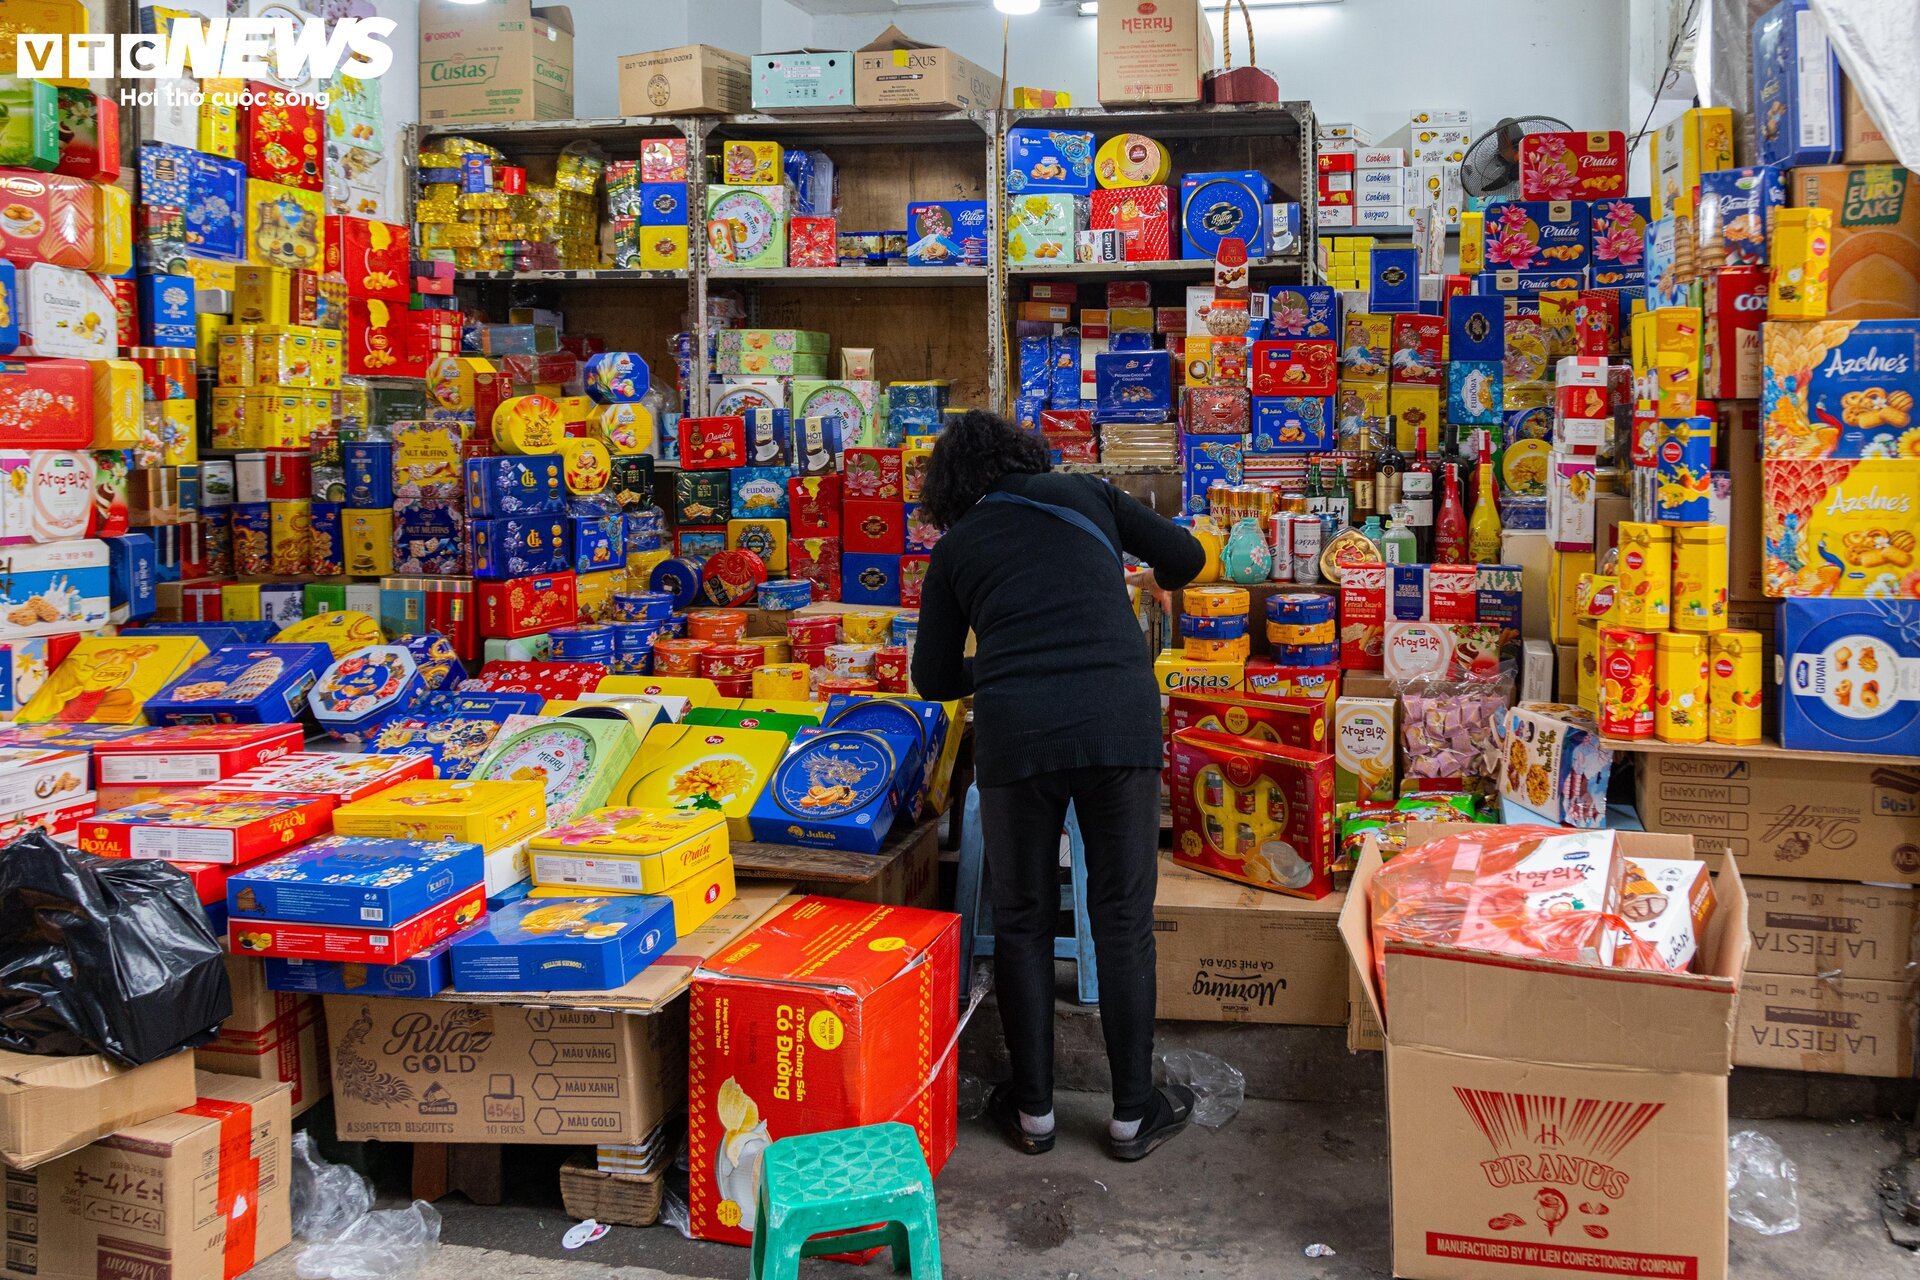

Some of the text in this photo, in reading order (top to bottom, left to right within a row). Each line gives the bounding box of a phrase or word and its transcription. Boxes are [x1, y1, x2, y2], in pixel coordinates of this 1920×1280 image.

[1121, 17, 1173, 33] MERRY
[434, 30, 461, 40] ORION
[431, 61, 487, 82] Custas
[536, 63, 564, 83] Custas
[65, 156, 91, 164] Coffee
[1365, 153, 1391, 164] Cookies
[1579, 155, 1618, 168] Praise
[1365, 172, 1391, 182] Cookies
[1365, 191, 1391, 202] Cookies
[957, 209, 985, 223] Ritaz
[1364, 209, 1389, 220] Cookies
[1845, 199, 1900, 221] CAKE
[1540, 224, 1579, 238] Praise
[1519, 279, 1549, 290] Praise
[43, 292, 81, 308] Chocolate
[1823, 347, 1910, 378] Azolne's
[704, 427, 733, 444] Daniel
[806, 432, 822, 440] HOT
[38, 470, 91, 496] 자연의맛
[1826, 486, 1911, 516] Azolne's
[1393, 636, 1441, 653] 자연의맛
[1165, 671, 1230, 689] Custas
[1250, 673, 1278, 688] Tipo
[1297, 673, 1324, 689] Tipo
[1815, 656, 1826, 694] GIOVANI
[1341, 725, 1387, 742] 자연의맛
[257, 745, 288, 764] Praise
[537, 751, 566, 771] MERRY
[1698, 762, 1726, 777] MÀU
[1663, 785, 1725, 801] MÀU XANH
[1662, 809, 1726, 827] MÀU VÀNG
[1810, 806, 1861, 815] PREMIUM
[268, 812, 306, 834] ROYAL
[1759, 804, 1861, 849] Draft
[806, 830, 836, 840] Julie's
[80, 838, 123, 852] ROYAL
[680, 843, 712, 867] Praise
[1501, 863, 1596, 888] 자연의맛
[1751, 930, 1878, 960] LA FIESTA
[1199, 957, 1274, 972] CÀ PHÊ SỮA ĐÁ
[1192, 970, 1287, 1007] Morning
[559, 1012, 579, 1025] MÀU
[382, 1007, 495, 1055] Ritaz
[795, 1021, 806, 1043] Yến
[1751, 1025, 1878, 1056] LA FIESTA
[562, 1045, 611, 1059] MÀU VÀNG
[773, 1004, 794, 1101] Có Đường
[793, 1043, 806, 1078] Chưng
[402, 1054, 477, 1074] GOLD
[565, 1079, 615, 1093] MÀU XANH
[486, 1106, 521, 1120] 454g
[567, 1113, 616, 1128] MÀU GOLD
[346, 1121, 455, 1133] ASSORTED BISCUITS
[486, 1125, 526, 1135] 10 BOXS
[1480, 1153, 1630, 1199] URANUS
[73, 1166, 164, 1204] ドライケーキ
[85, 1202, 162, 1233] ドライスコーン
[1436, 1237, 1511, 1260] MANUFACTURED
[1511, 1246, 1525, 1260] BY
[1540, 1249, 1562, 1265] LIEN
[1562, 1251, 1639, 1272] CONFECTIONERY
[1640, 1259, 1686, 1276] COMPANY
